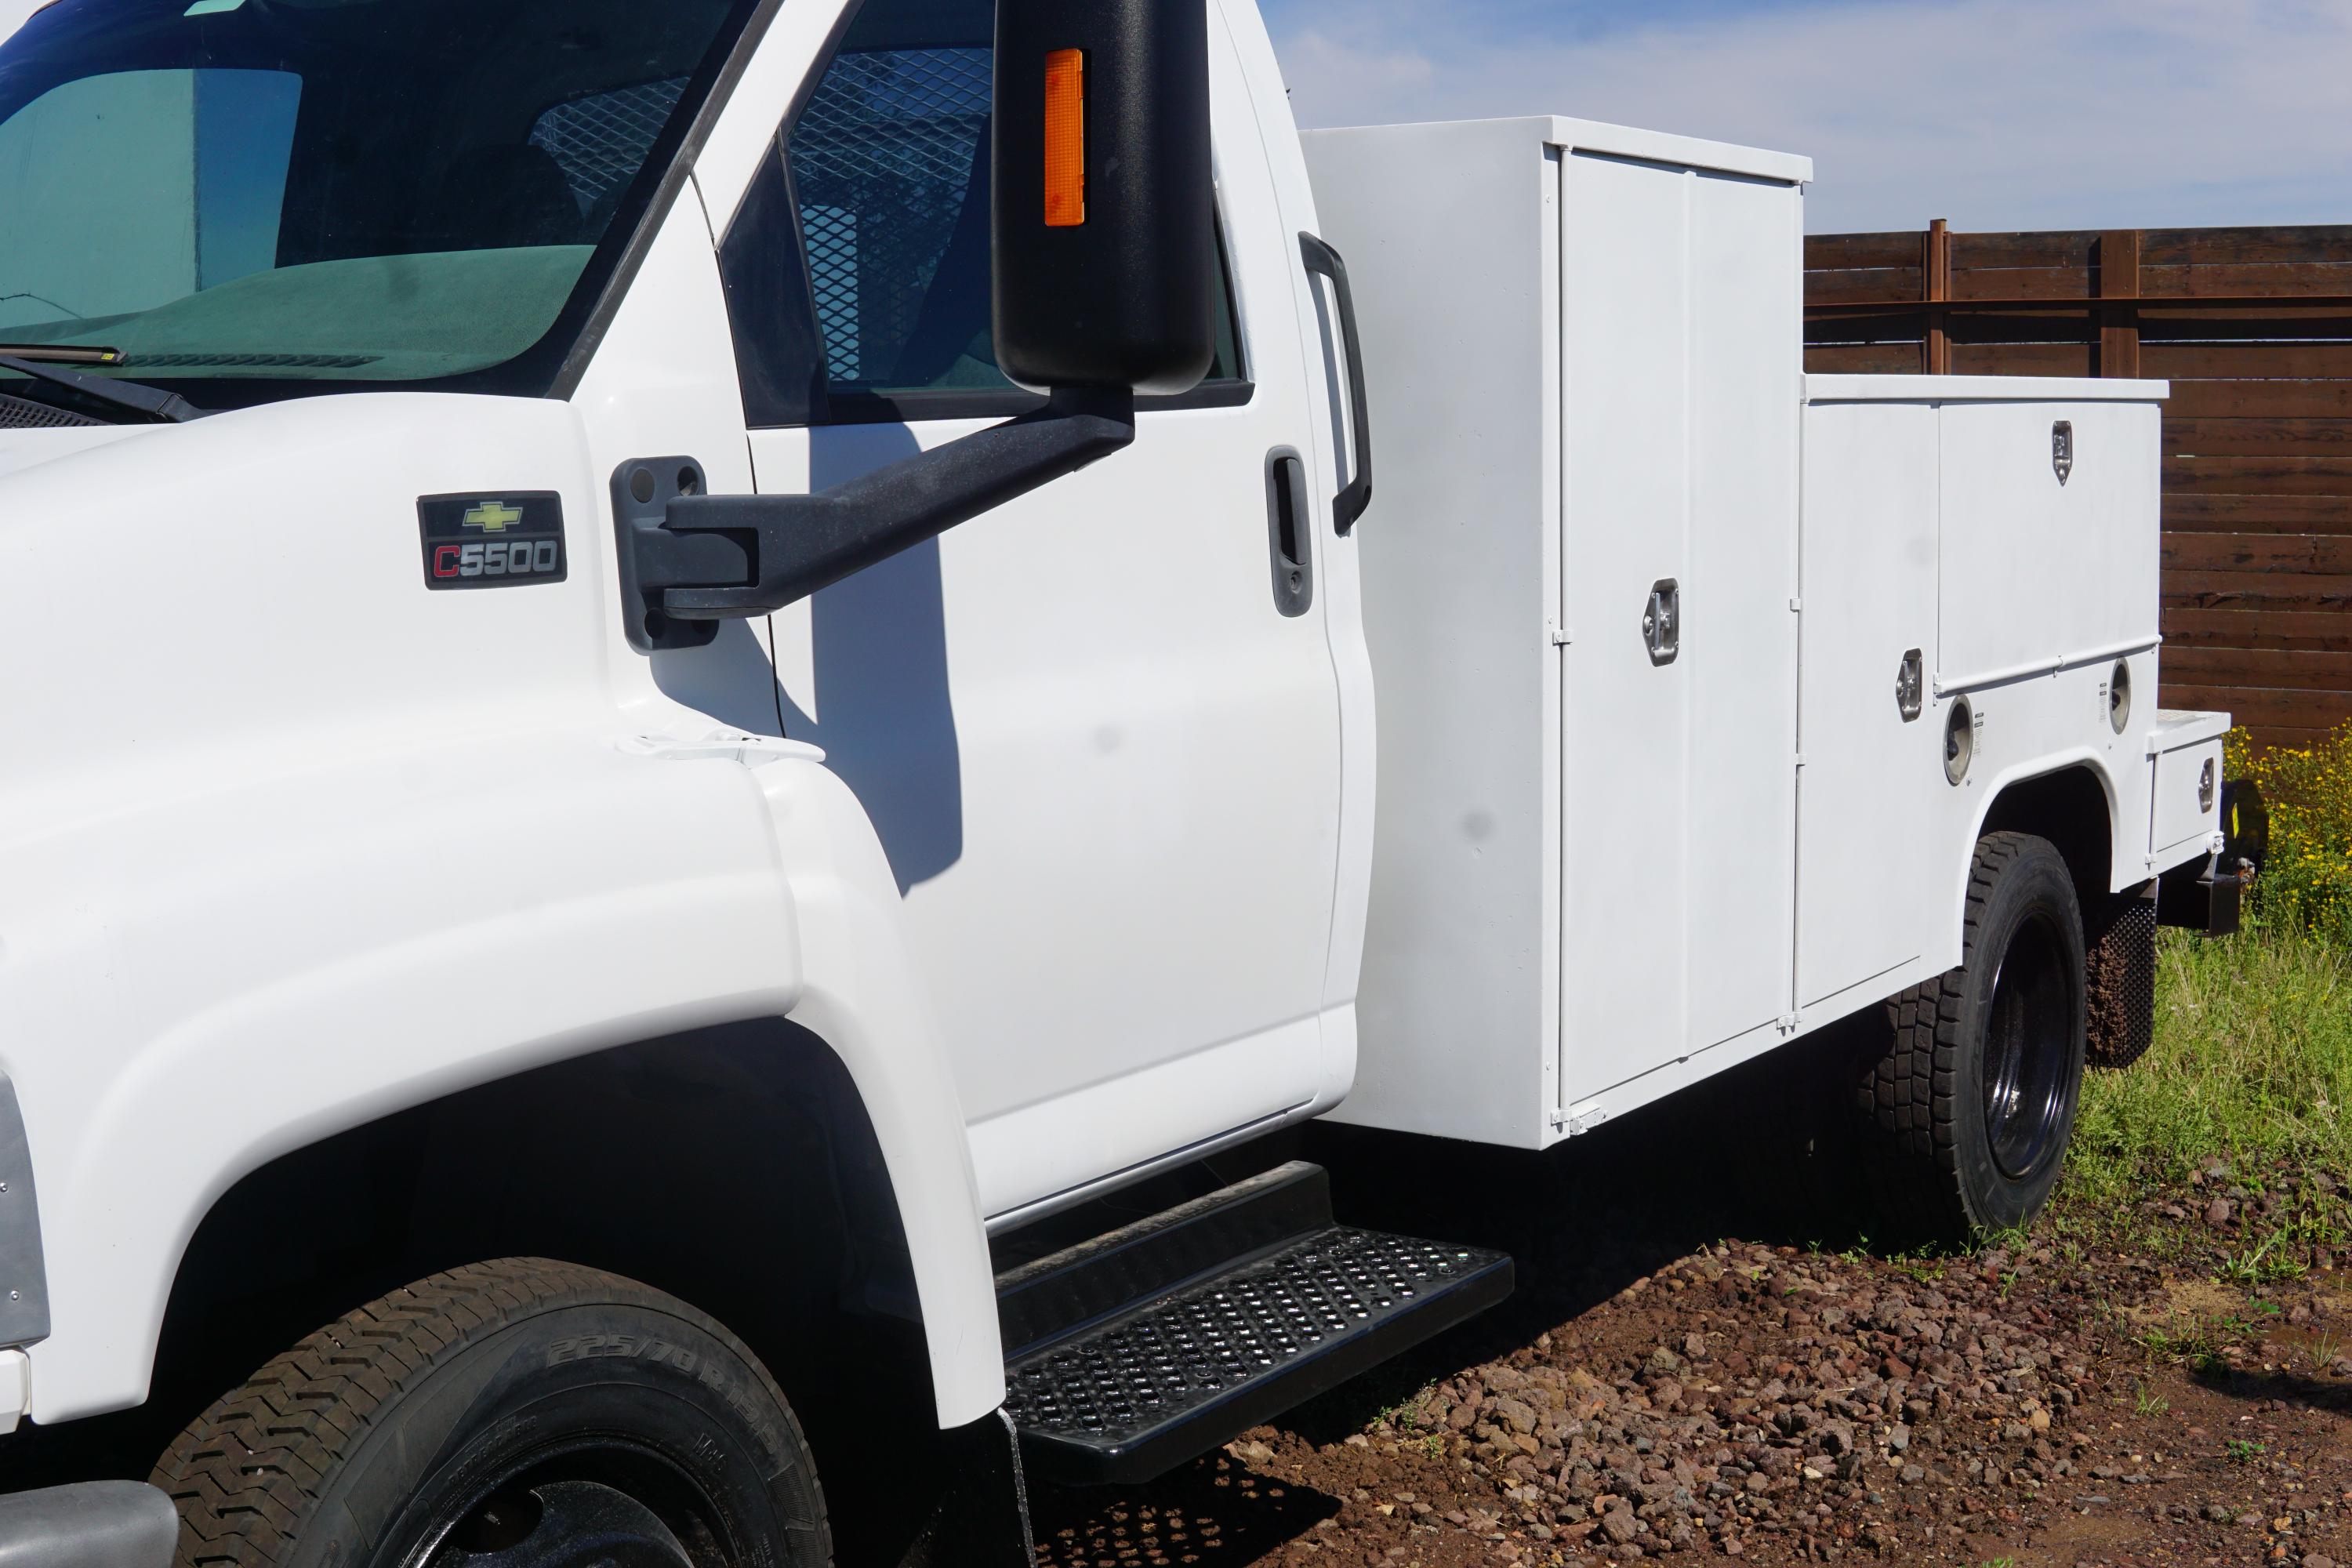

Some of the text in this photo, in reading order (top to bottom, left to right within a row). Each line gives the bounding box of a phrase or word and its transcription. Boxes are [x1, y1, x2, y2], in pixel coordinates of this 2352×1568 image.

[434, 540, 557, 578] C5500
[547, 1334, 698, 1373] 225/70
[699, 1361, 725, 1392] R
